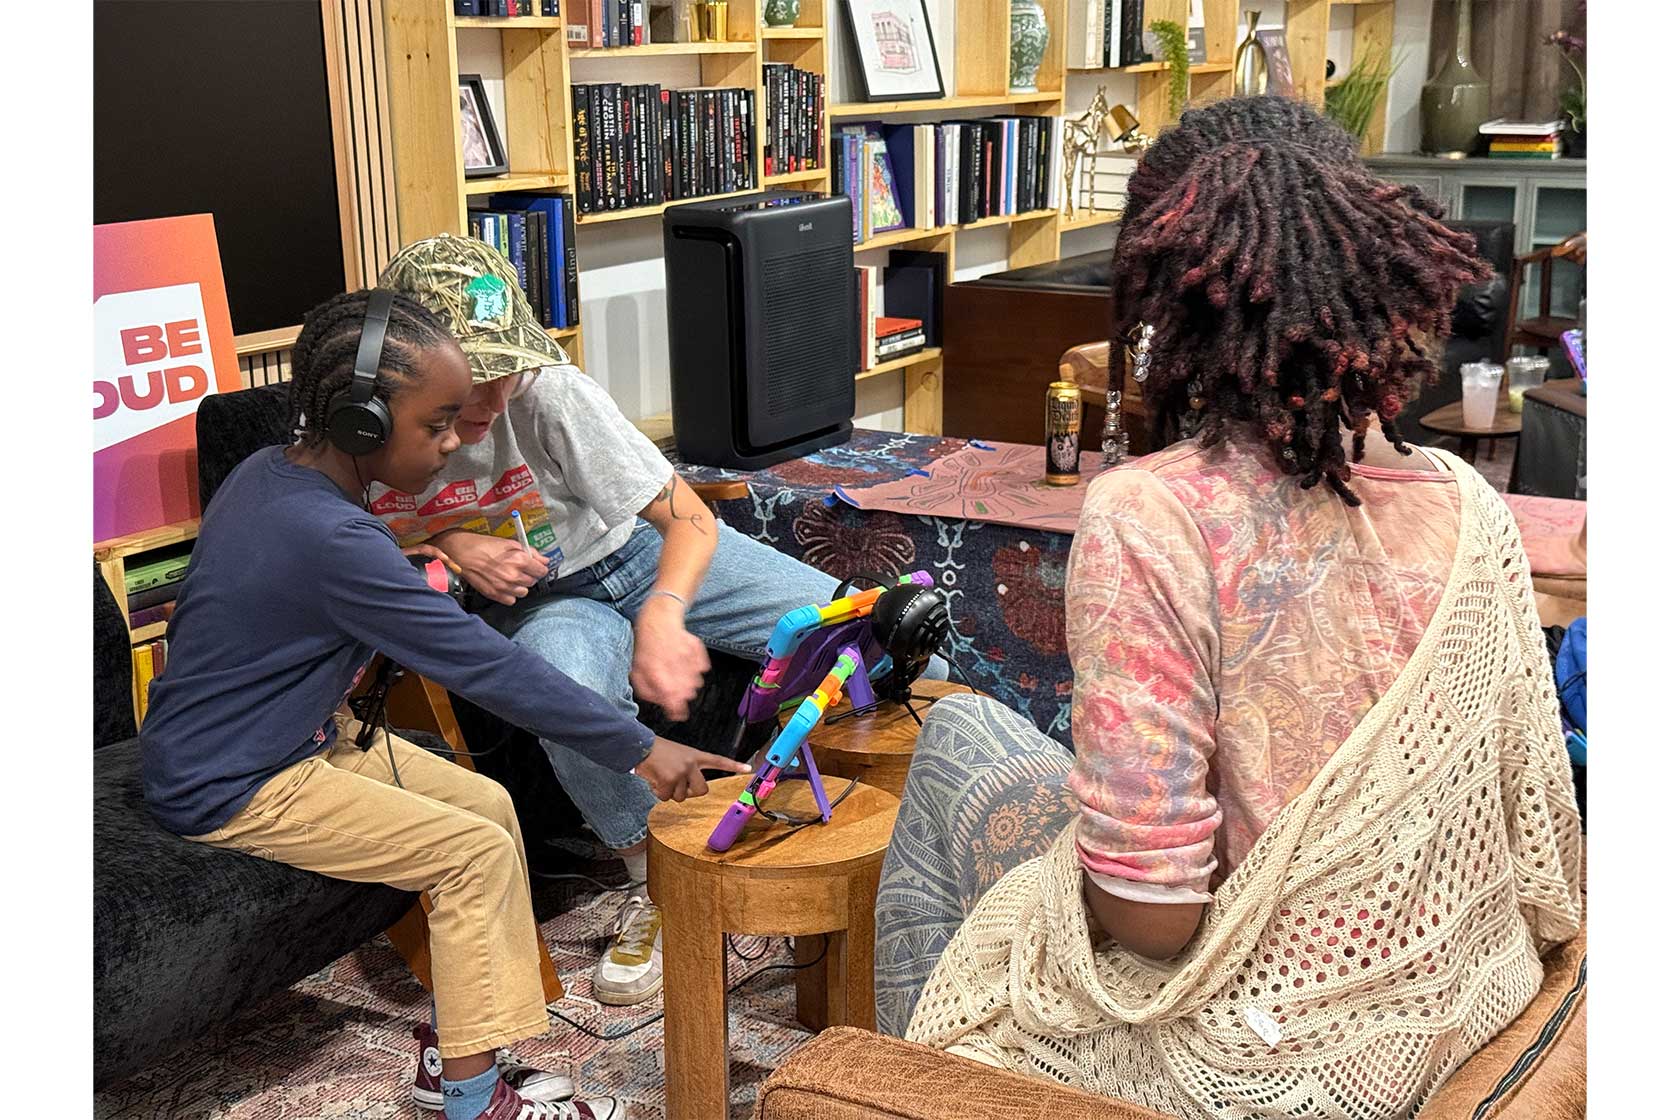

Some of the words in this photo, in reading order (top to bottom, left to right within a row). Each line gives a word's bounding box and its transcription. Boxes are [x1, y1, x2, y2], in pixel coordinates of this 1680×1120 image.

[607, 102, 615, 136] JUSTIN
[567, 248, 576, 282] Mine!
[120, 318, 202, 366] BE
[94, 366, 208, 420] OUD
[357, 430, 378, 438] SONY
[510, 470, 530, 482] BE
[454, 486, 476, 494] BE
[495, 478, 532, 495] LOUD
[376, 502, 416, 511] LOUD
[435, 494, 477, 507] LOUD
[533, 529, 552, 541] BE
